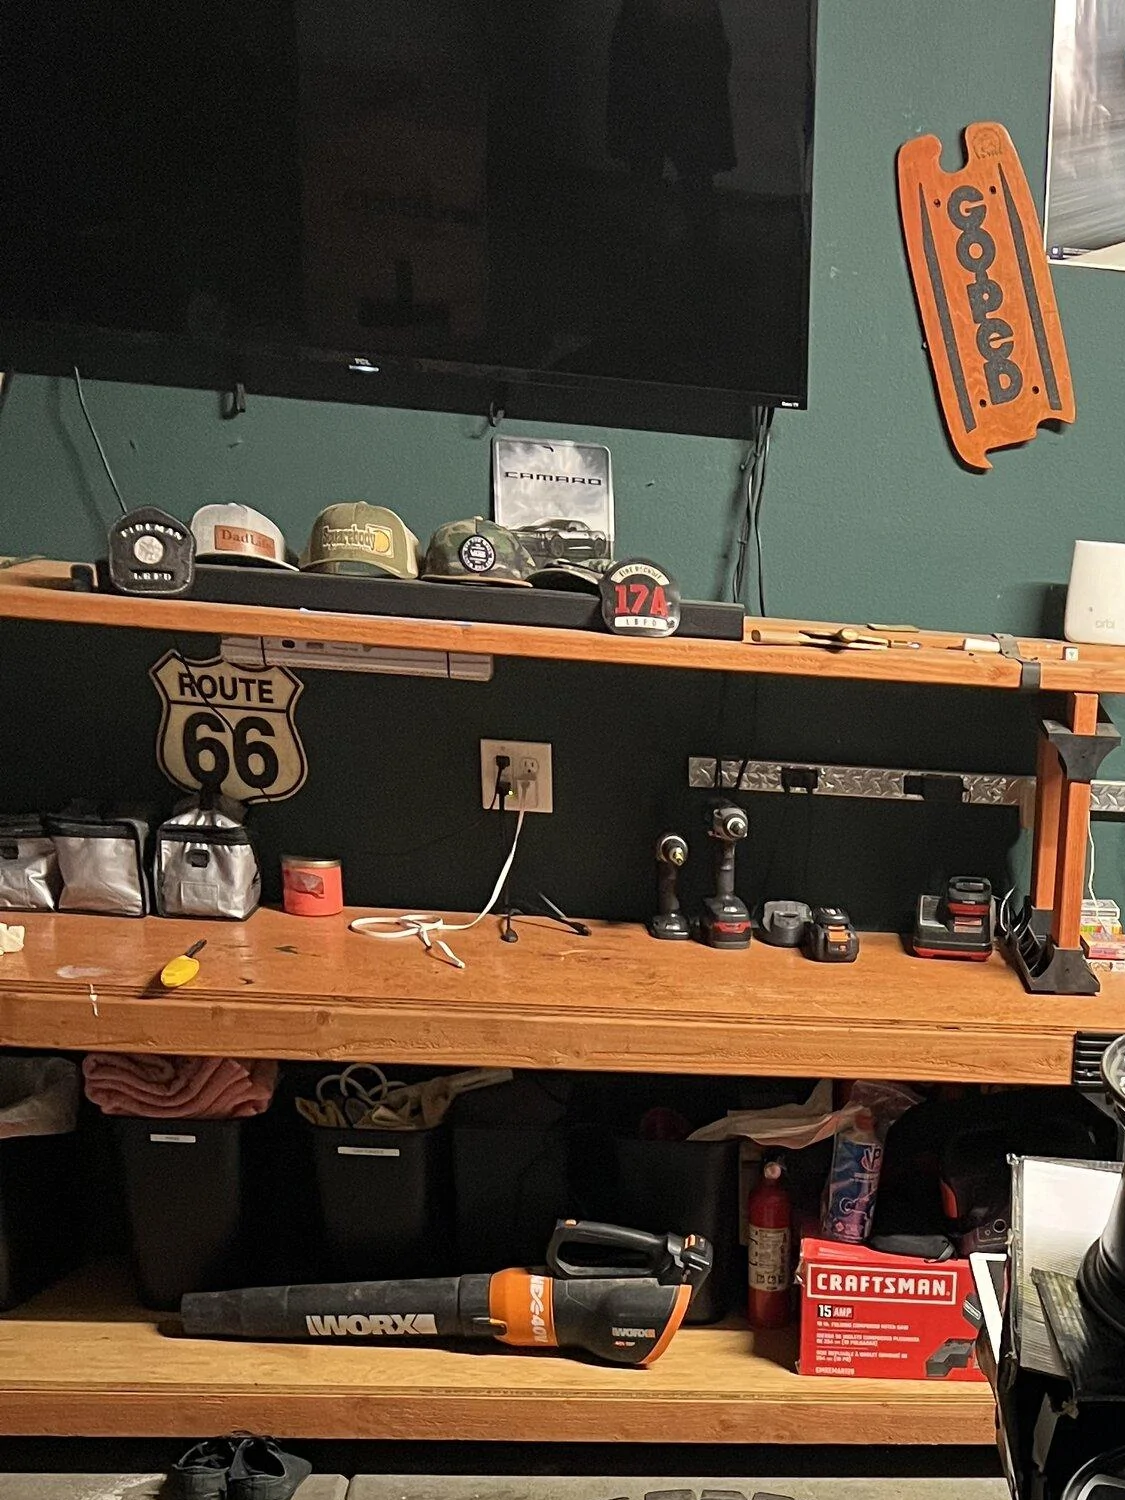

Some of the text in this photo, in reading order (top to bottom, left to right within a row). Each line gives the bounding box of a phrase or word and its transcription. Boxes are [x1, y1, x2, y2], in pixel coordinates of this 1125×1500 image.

[504, 471, 602, 486] CAMARO
[120, 523, 183, 541] FIREMAN
[614, 583, 669, 617] 17A
[177, 673, 275, 704] ROUTE
[182, 711, 279, 790] 66
[816, 1273, 946, 1296] CRAFTSMAN
[818, 1304, 852, 1318] 15 AMP
[308, 1313, 432, 1336] WORX
